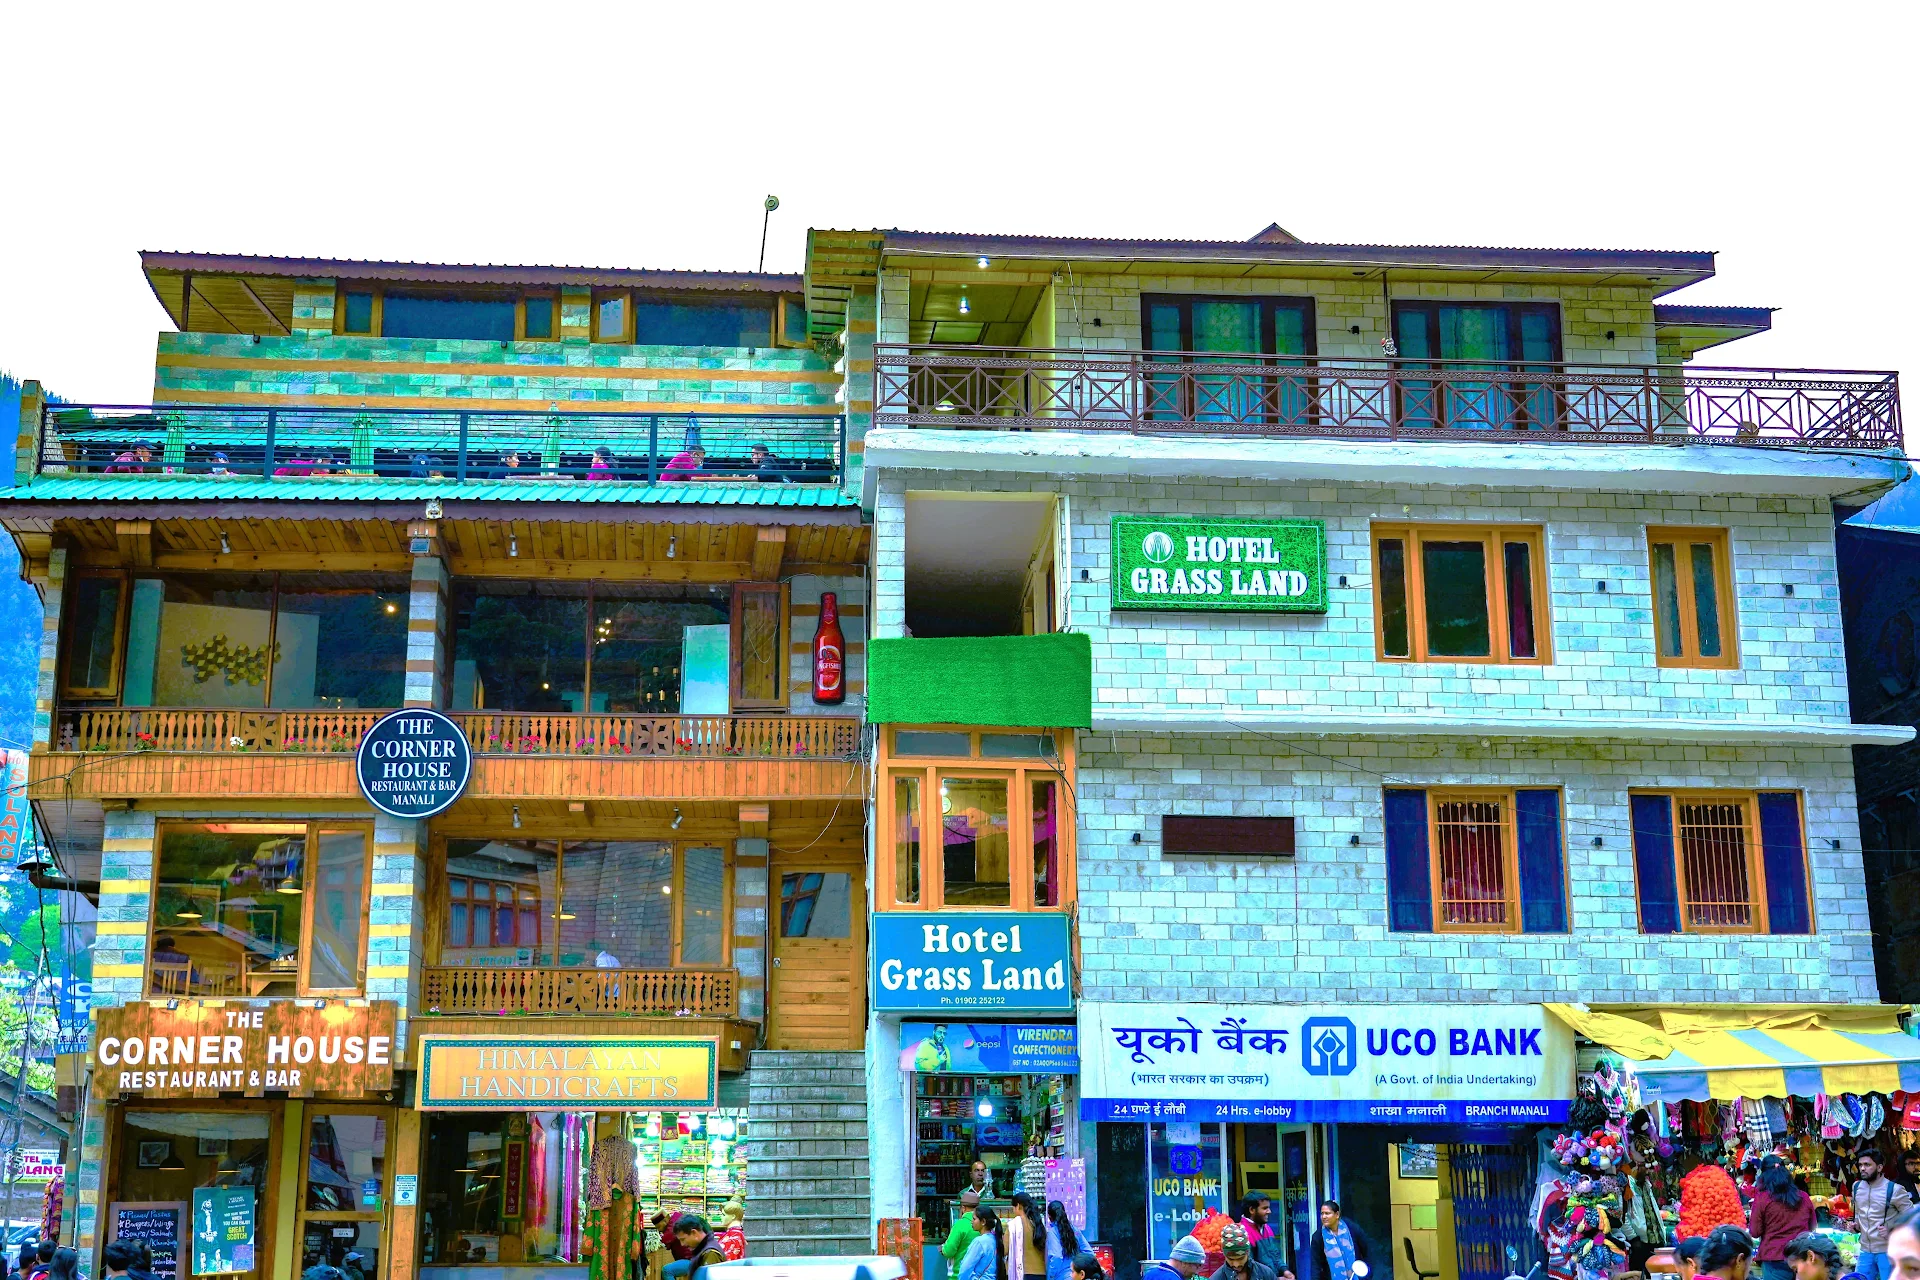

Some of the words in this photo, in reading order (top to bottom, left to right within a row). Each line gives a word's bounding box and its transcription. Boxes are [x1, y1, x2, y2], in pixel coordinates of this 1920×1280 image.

[1186, 536, 1281, 563] HOTEL
[1131, 568, 1224, 595] GRASS
[1230, 569, 1308, 597] LAND
[397, 718, 434, 735] THE
[371, 739, 457, 758] CORNER
[382, 761, 452, 778] HOUSE
[371, 780, 429, 792] RESTAURANT
[429, 780, 437, 791] &
[438, 780, 457, 791] BAR
[392, 794, 435, 806] MANALI
[0, 768, 27, 859] SOLANG
[922, 924, 1022, 953] Hotel
[880, 959, 972, 991] Grass
[981, 959, 1065, 991] Land
[226, 1011, 263, 1028] THE
[1017, 1028, 1074, 1041] VIRENDRA
[1111, 1017, 1203, 1064] यूको
[1211, 1017, 1290, 1054] बैंक
[1366, 1028, 1437, 1056] UCO
[1449, 1028, 1543, 1056] BANK
[99, 1036, 244, 1065] CORNER
[267, 1036, 390, 1065] HOUSE
[976, 1041, 1001, 1050] pepsi
[1012, 1045, 1077, 1055] CONFECTIONERY
[476, 1049, 662, 1070] HIMALAYAN
[119, 1070, 244, 1089] RESTAURANT
[249, 1070, 260, 1087] &
[265, 1070, 301, 1087] BAR
[460, 1076, 678, 1098] HANDICRAFTS
[1131, 1072, 1165, 1086] (भारत
[1169, 1074, 1206, 1085] सरकार
[1209, 1075, 1224, 1085] का
[1228, 1073, 1269, 1087] उपक्रम)
[1375, 1074, 1388, 1087] (A
[1390, 1075, 1419, 1085] Govt.
[1422, 1075, 1434, 1085] of
[1436, 1075, 1463, 1085] India
[1466, 1074, 1537, 1087] Undertaking)
[1114, 1105, 1128, 1114] 24
[1131, 1102, 1151, 1115] घण्टे
[1153, 1102, 1161, 1117] ई
[1216, 1105, 1228, 1115] 24
[1231, 1105, 1251, 1116] Hrs.
[1254, 1105, 1292, 1118] e-lobby
[1370, 1107, 1402, 1116] शाखा
[1406, 1104, 1447, 1116] मनाली
[1466, 1106, 1508, 1116] BRANCH
[1510, 1106, 1549, 1116] MANALI
[1154, 1179, 1180, 1196] UCO
[1184, 1179, 1218, 1196] BANK
[1154, 1208, 1210, 1222] e-Lobb
[227, 1232, 248, 1241] SCOTCH
[228, 1225, 246, 1233] GREAT
